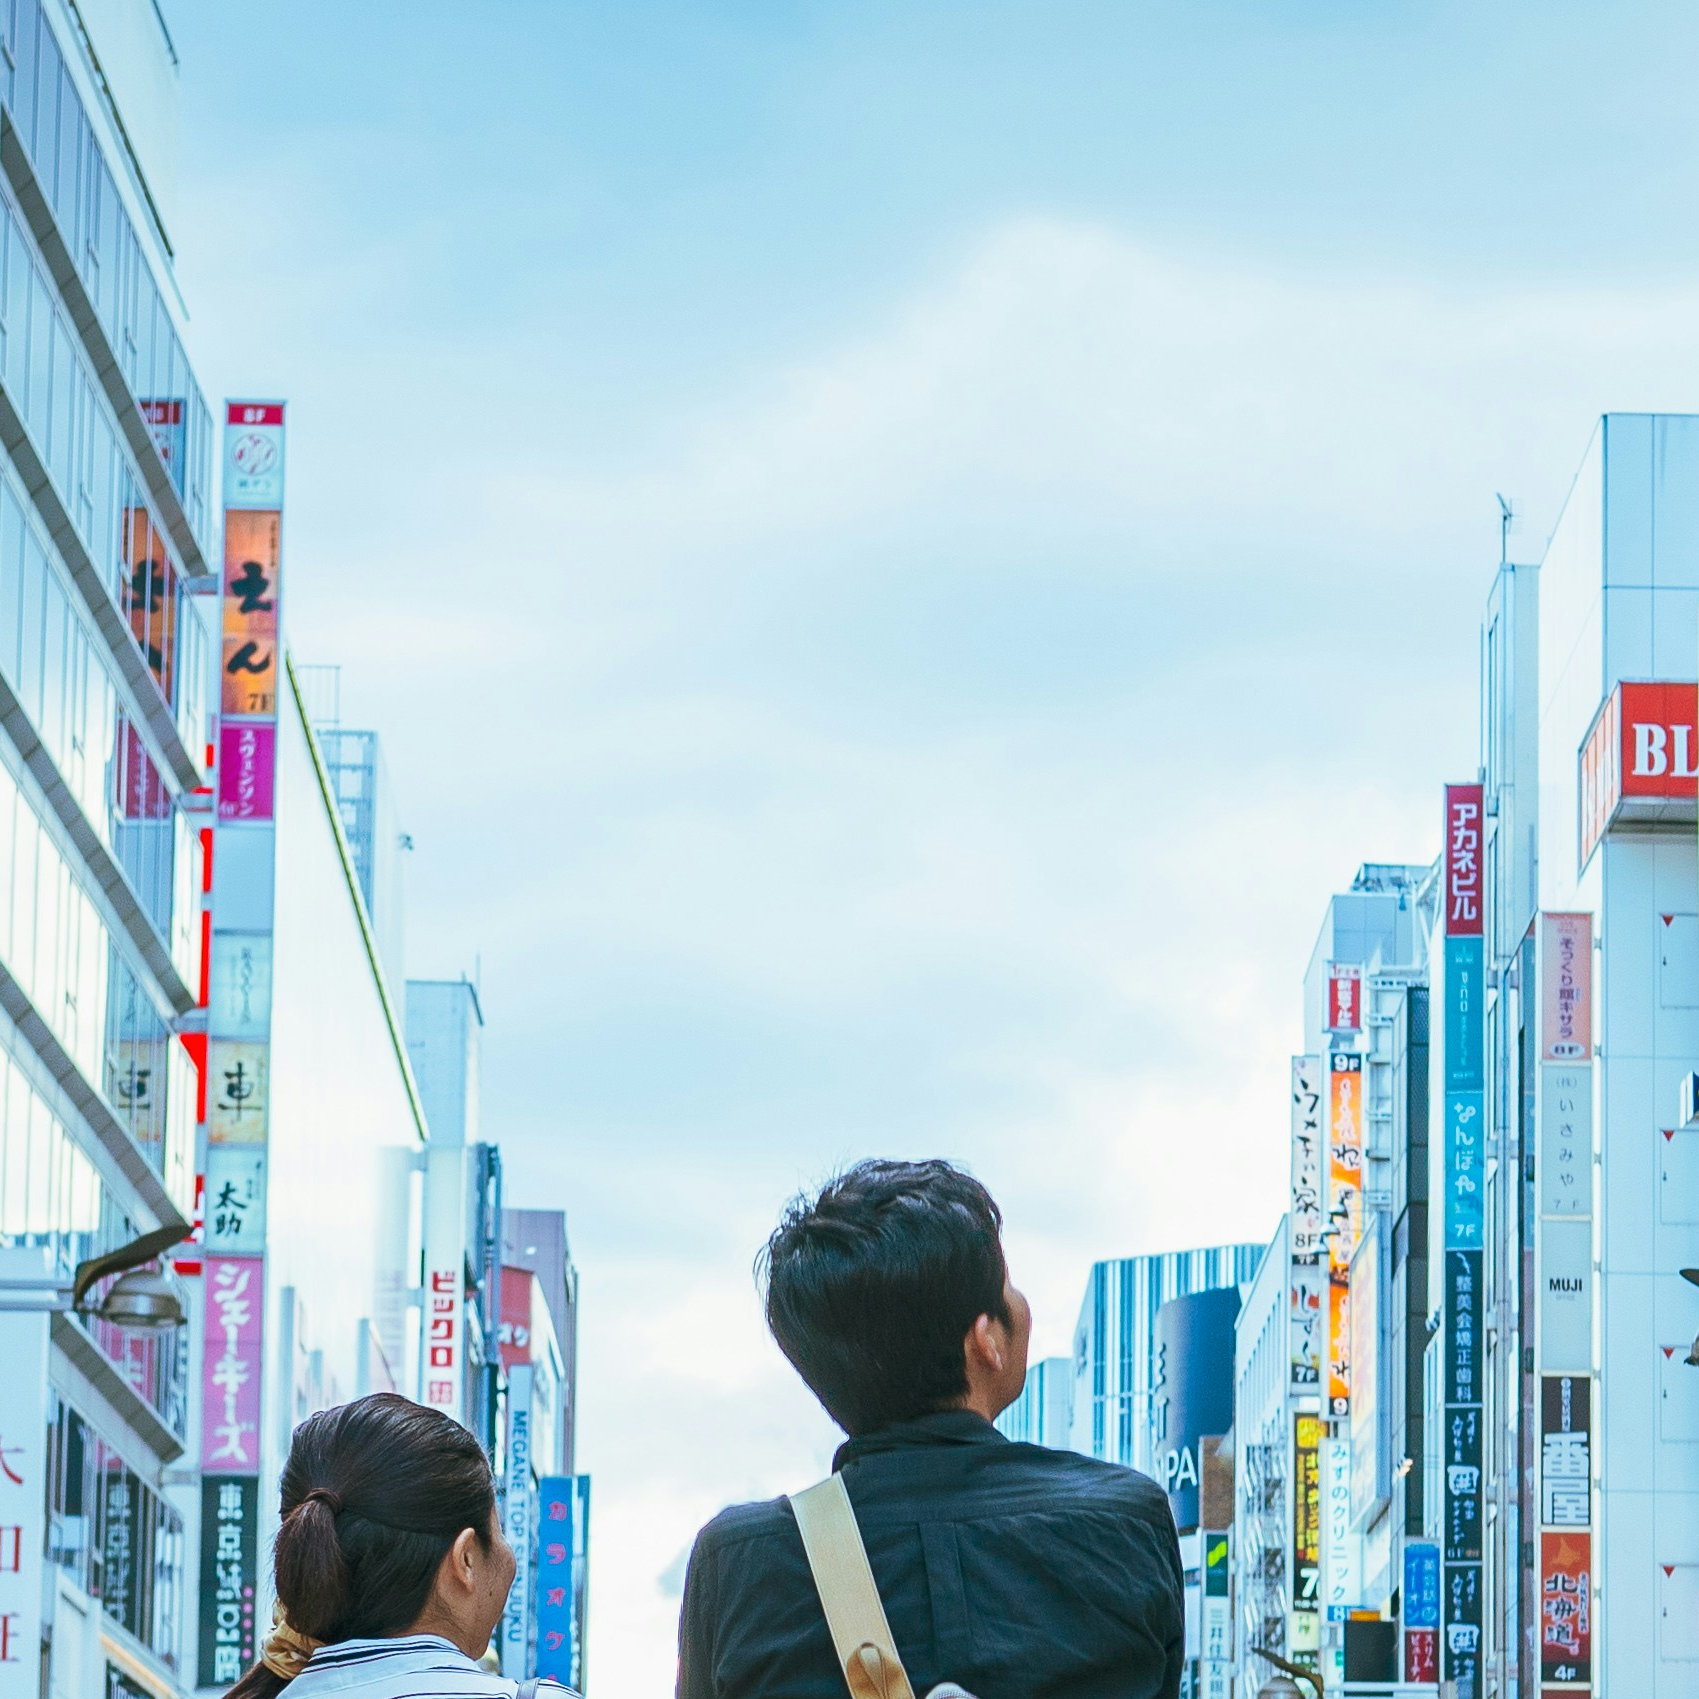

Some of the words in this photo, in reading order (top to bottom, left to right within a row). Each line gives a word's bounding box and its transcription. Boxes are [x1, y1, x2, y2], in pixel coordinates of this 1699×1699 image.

[231, 561, 272, 673] えん
[1452, 804, 1478, 921] アカネビル
[1334, 1055, 1359, 1071] 9F
[1454, 1103, 1476, 1195] なんぼや
[1455, 1224, 1476, 1237] 7F
[1549, 1279, 1583, 1292] MUJI
[511, 1410, 528, 1490] MEGANE
[1543, 1432, 1590, 1526] 番屋
[510, 1501, 526, 1537] TOP
[1331, 1445, 1348, 1600] みずのクリニック
[1544, 1573, 1580, 1650] 北海道
[1555, 1665, 1577, 1680] 4F
